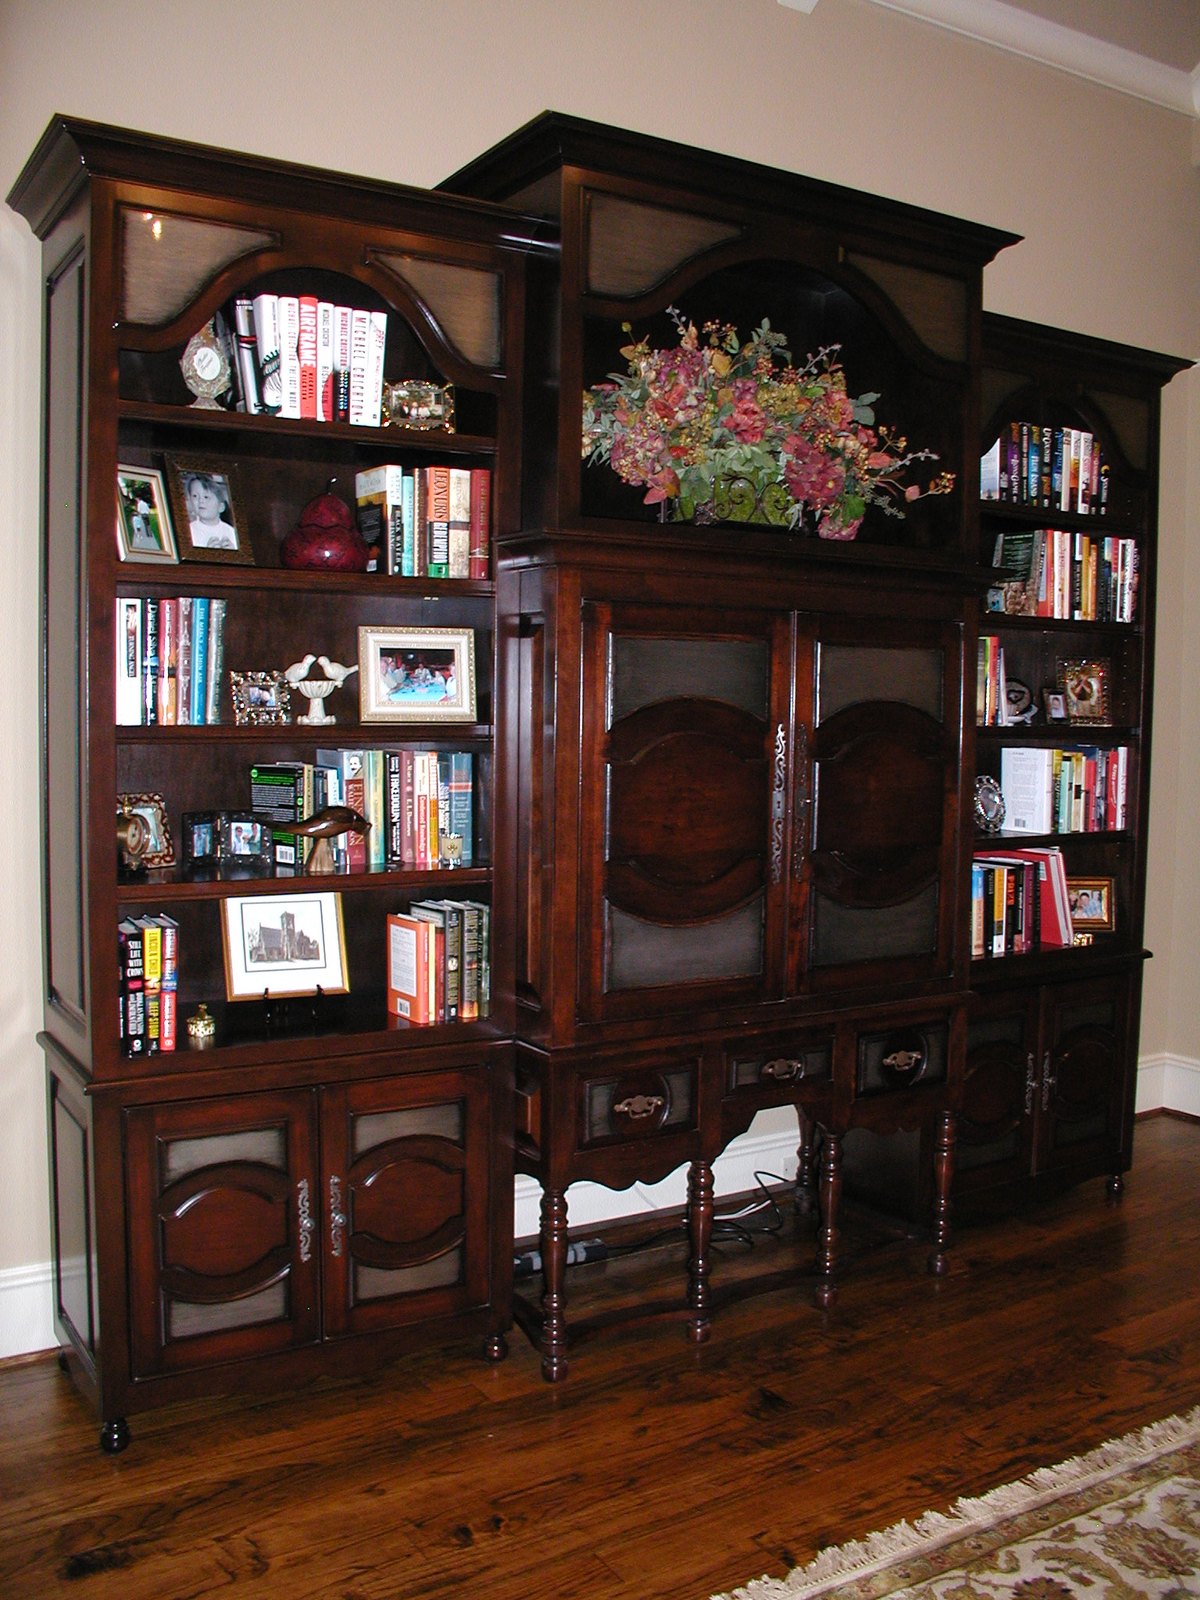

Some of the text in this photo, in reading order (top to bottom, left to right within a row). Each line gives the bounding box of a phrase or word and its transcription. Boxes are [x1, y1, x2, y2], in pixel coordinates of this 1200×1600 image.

[300, 304, 316, 368] AIRFRAME
[352, 317, 367, 416] MICHAEL CRICHTON
[433, 523, 448, 564] REDEMPTION
[148, 605, 157, 656] Daniel Silva
[354, 784, 363, 846] EINSN
[391, 774, 400, 822] TAKEDOWN
[148, 932, 158, 975] LINCOLN CHILD
[148, 1018, 159, 1038] STORM
